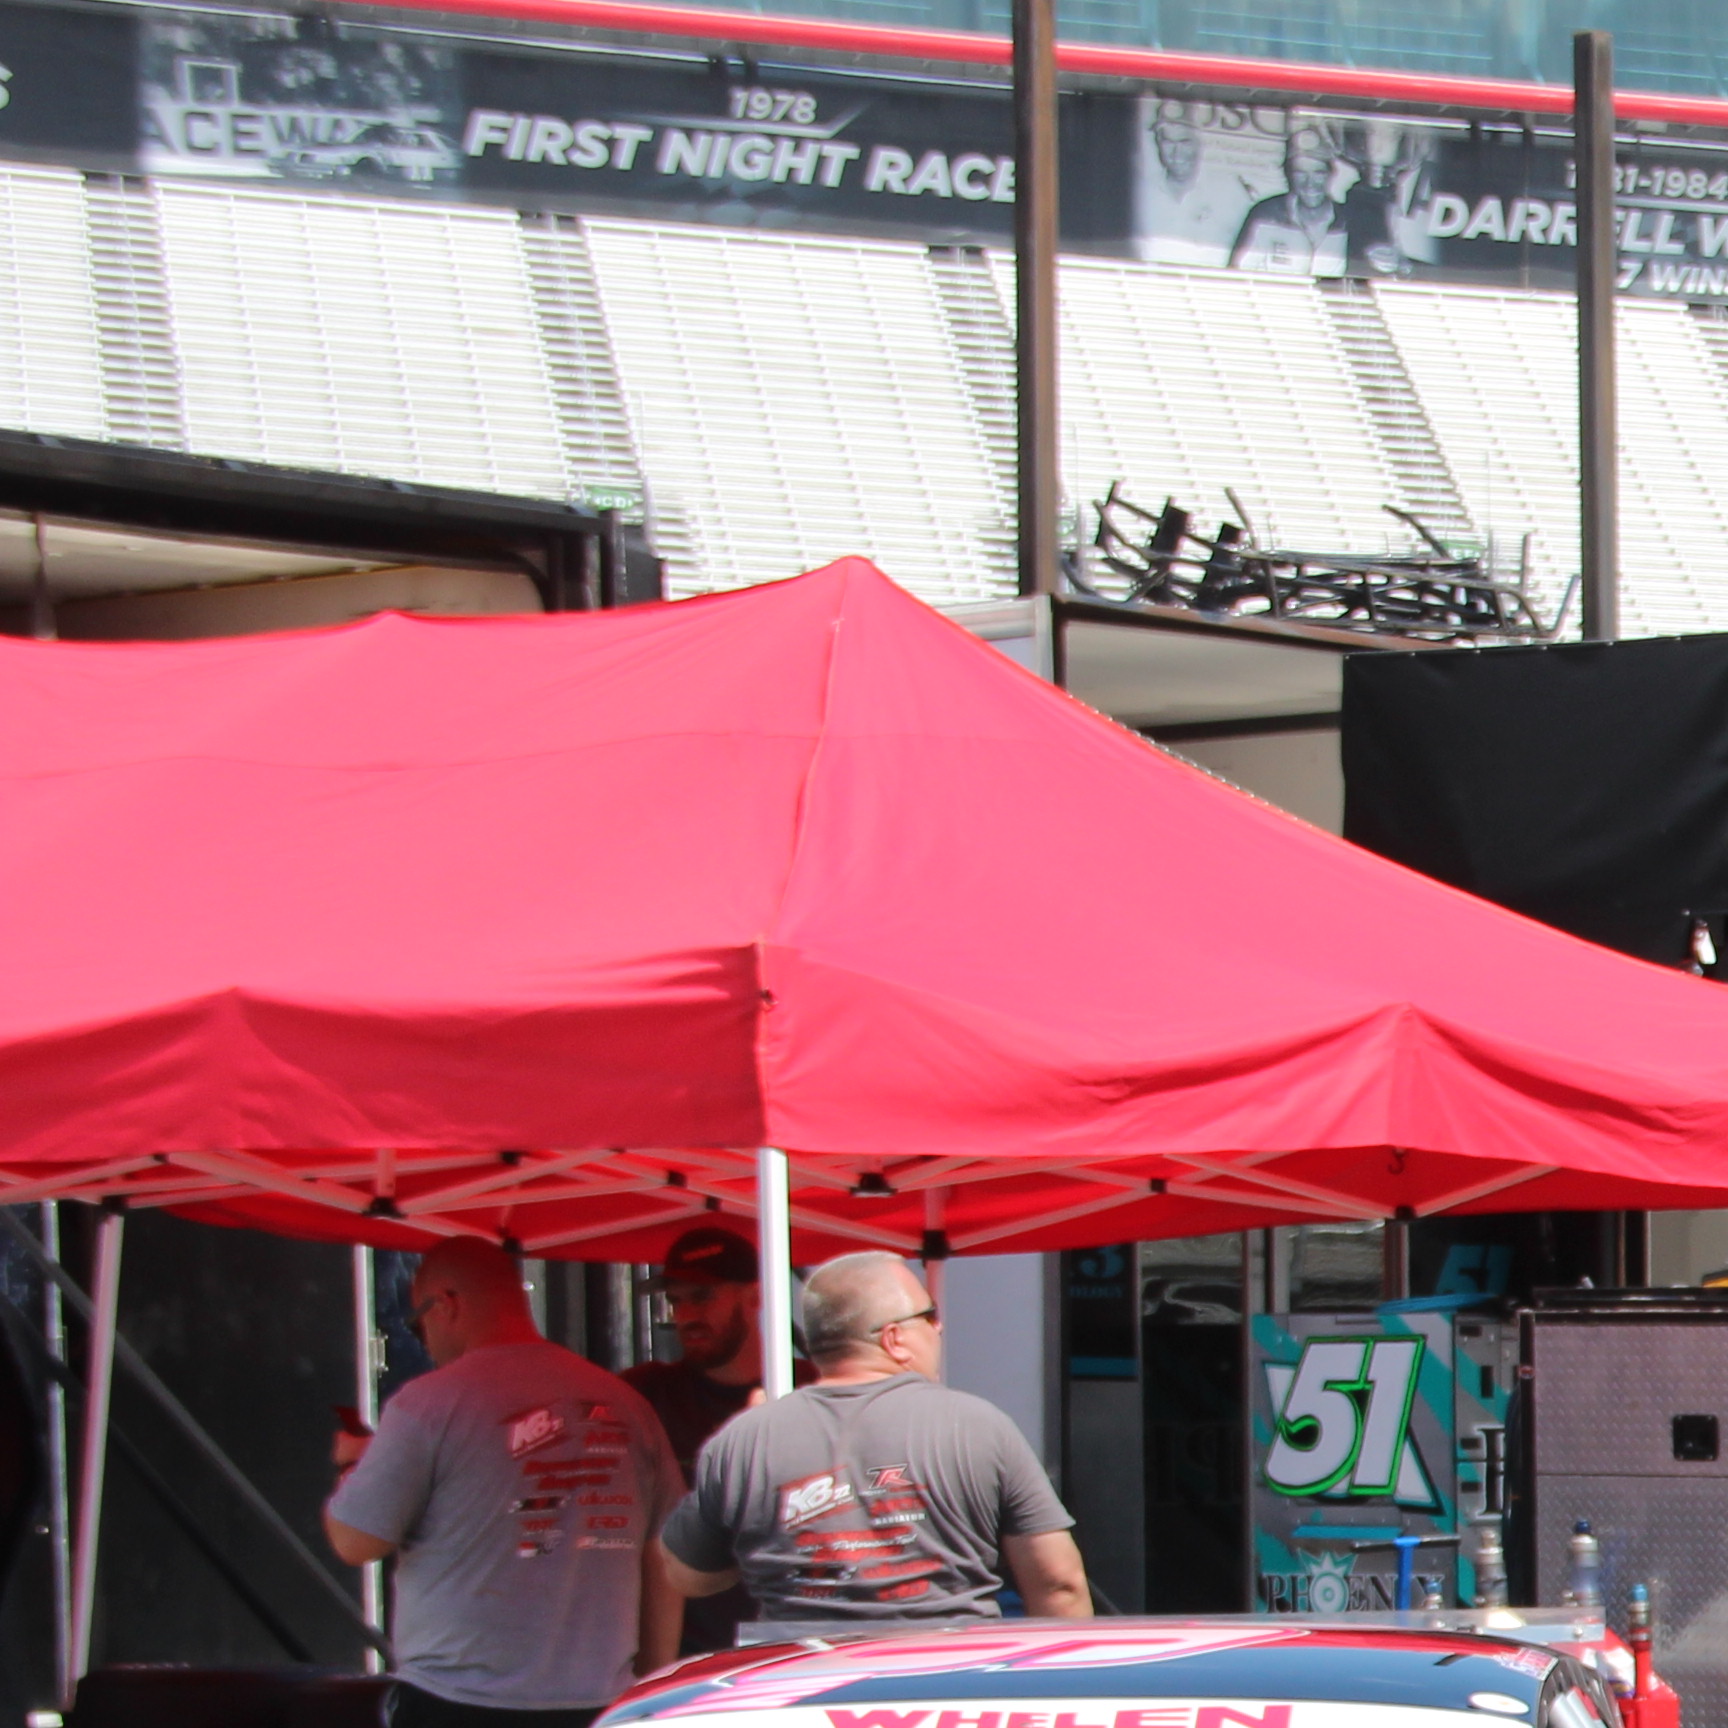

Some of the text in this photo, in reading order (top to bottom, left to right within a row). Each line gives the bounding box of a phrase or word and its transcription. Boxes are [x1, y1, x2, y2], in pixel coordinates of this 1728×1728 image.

[731, 87, 818, 124] 1978
[463, 108, 1015, 203] FIRST NIGHT RACE
[1428, 194, 1686, 256] DARRLL
[1617, 261, 1643, 290] 7
[1263, 1335, 1428, 1497] 51
[1261, 1572, 1446, 1613] PHOENX
